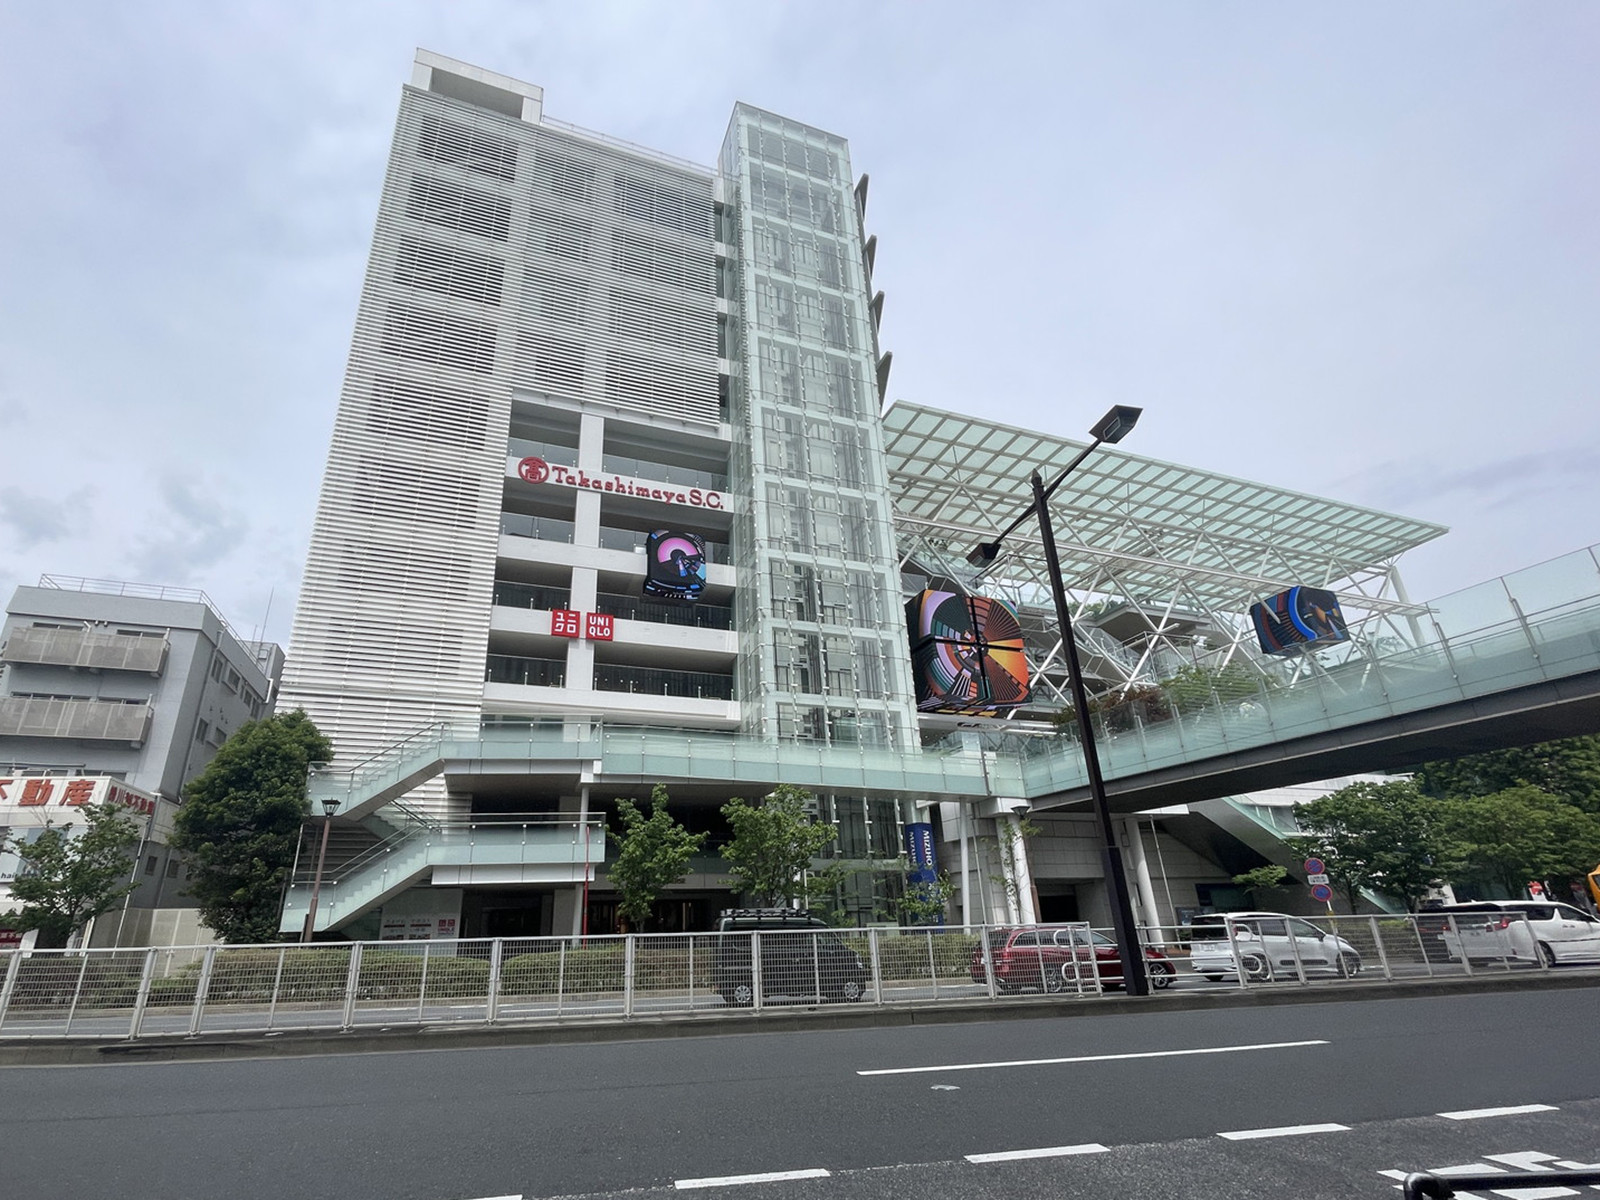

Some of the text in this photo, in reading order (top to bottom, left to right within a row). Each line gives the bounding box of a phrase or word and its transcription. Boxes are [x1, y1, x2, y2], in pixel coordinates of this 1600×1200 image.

[552, 466, 724, 509] Takashimaya S.C.
[922, 830, 933, 866] MIZUHO
